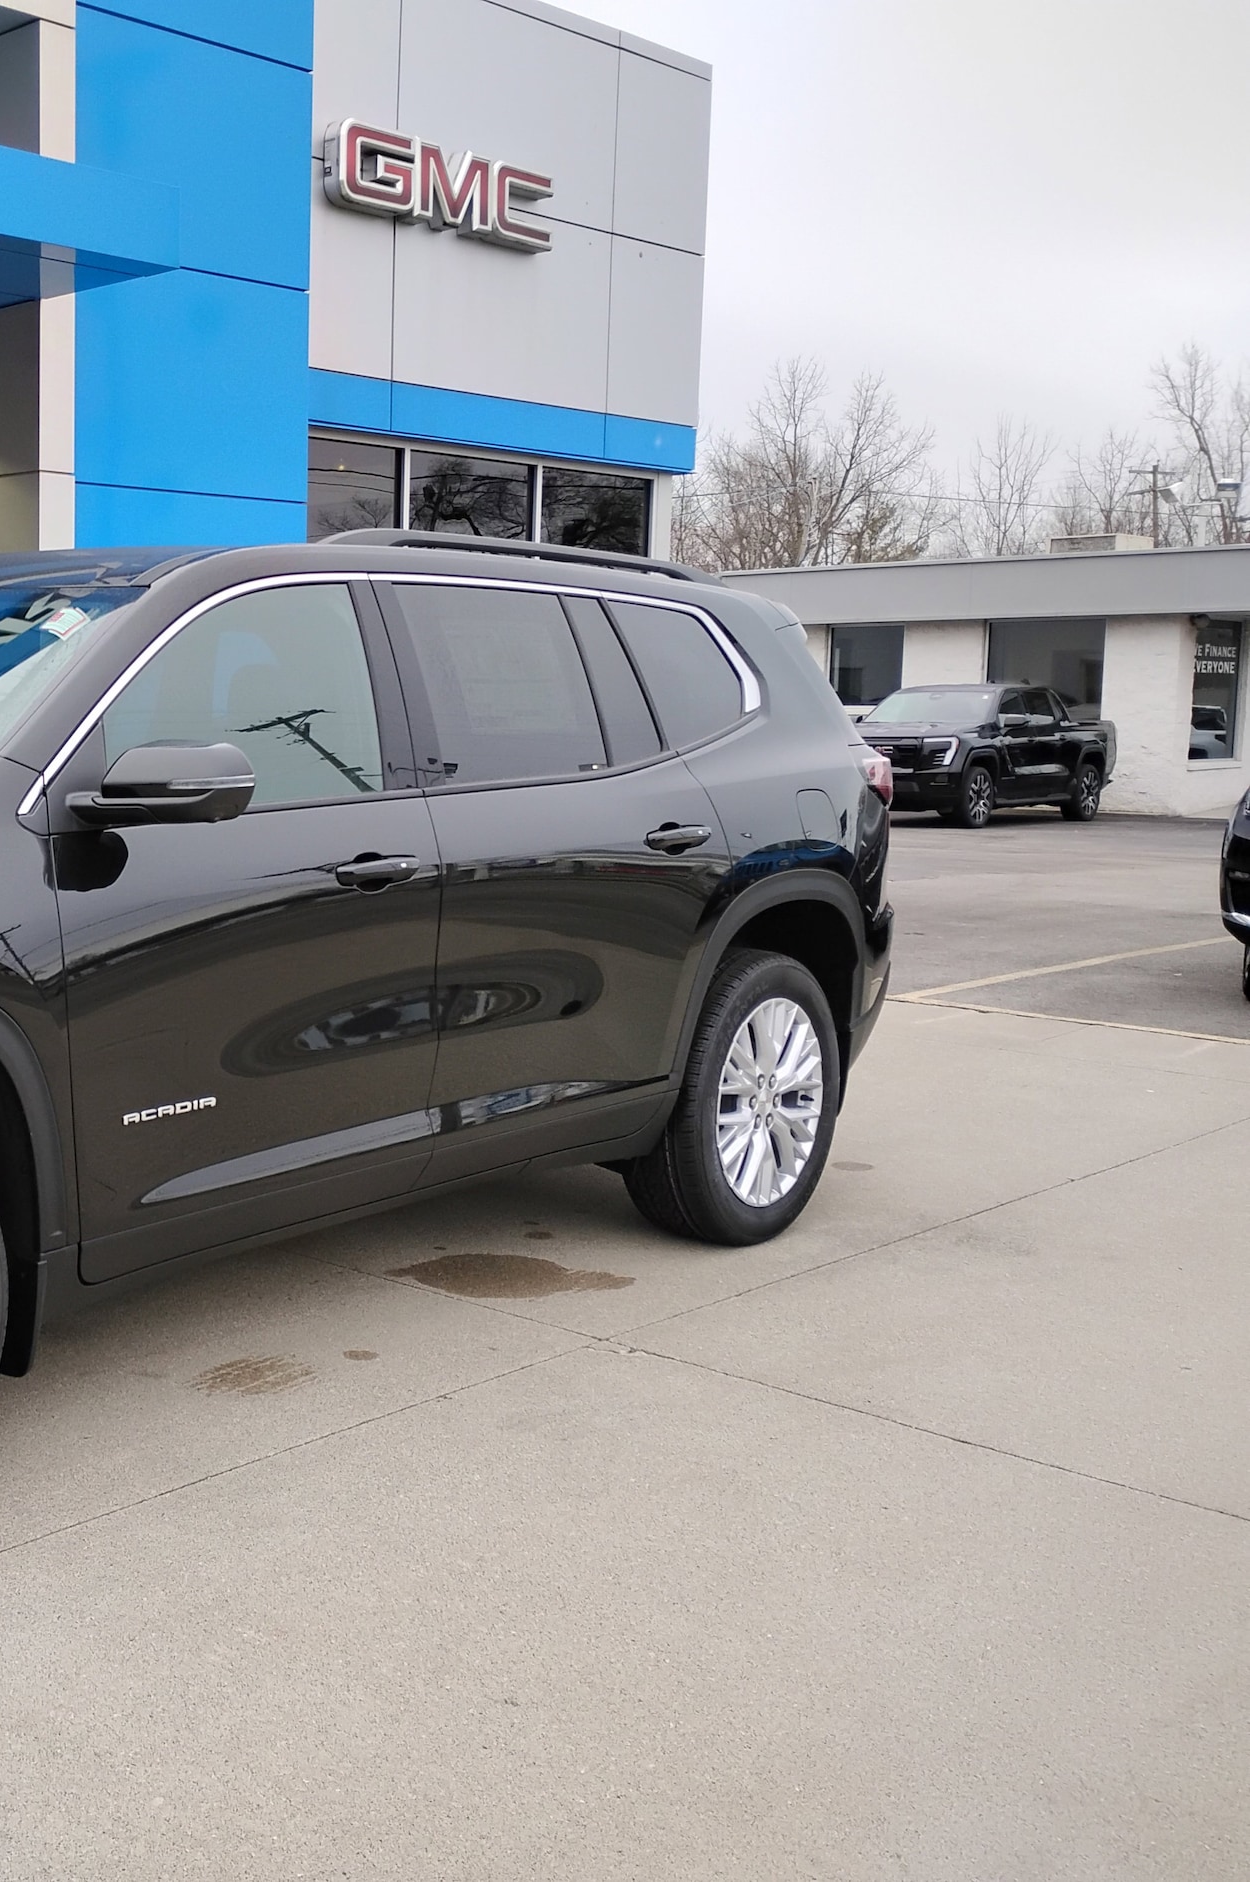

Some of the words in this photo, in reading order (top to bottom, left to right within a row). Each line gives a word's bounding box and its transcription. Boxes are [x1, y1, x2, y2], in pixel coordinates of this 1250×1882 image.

[324, 117, 553, 254] GMC
[1204, 643, 1237, 658] FINANCE
[1194, 660, 1236, 674] VERYONE
[122, 1096, 217, 1126] ACADIA
